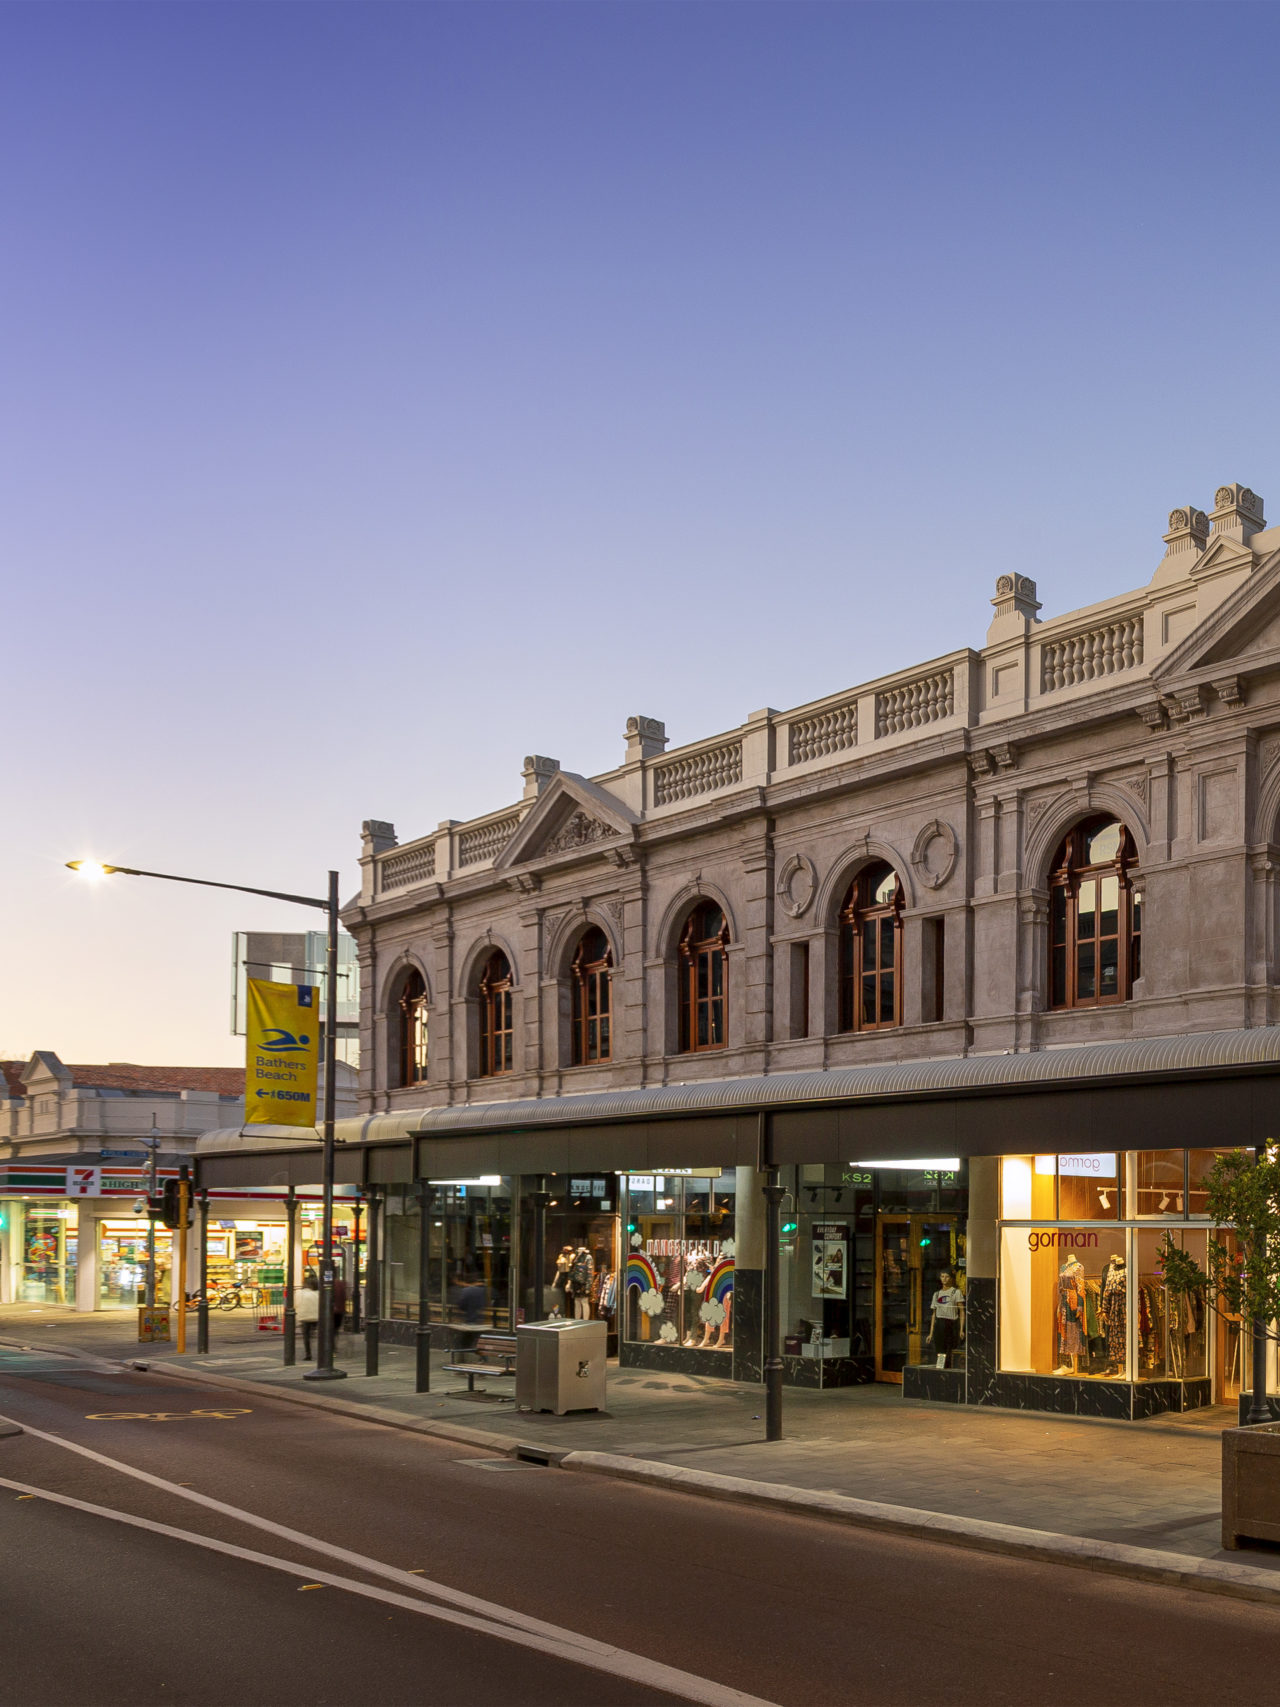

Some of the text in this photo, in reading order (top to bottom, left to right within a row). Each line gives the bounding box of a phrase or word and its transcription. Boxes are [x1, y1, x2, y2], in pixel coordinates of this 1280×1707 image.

[256, 1056, 307, 1071] Bathers
[255, 1068, 297, 1081] Beach
[277, 1089, 311, 1102] 650M
[842, 1172, 872, 1184] KS2
[108, 1181, 139, 1189] HIGH
[646, 1239, 720, 1258] DANGERFIELD
[1028, 1232, 1099, 1252] gorman
